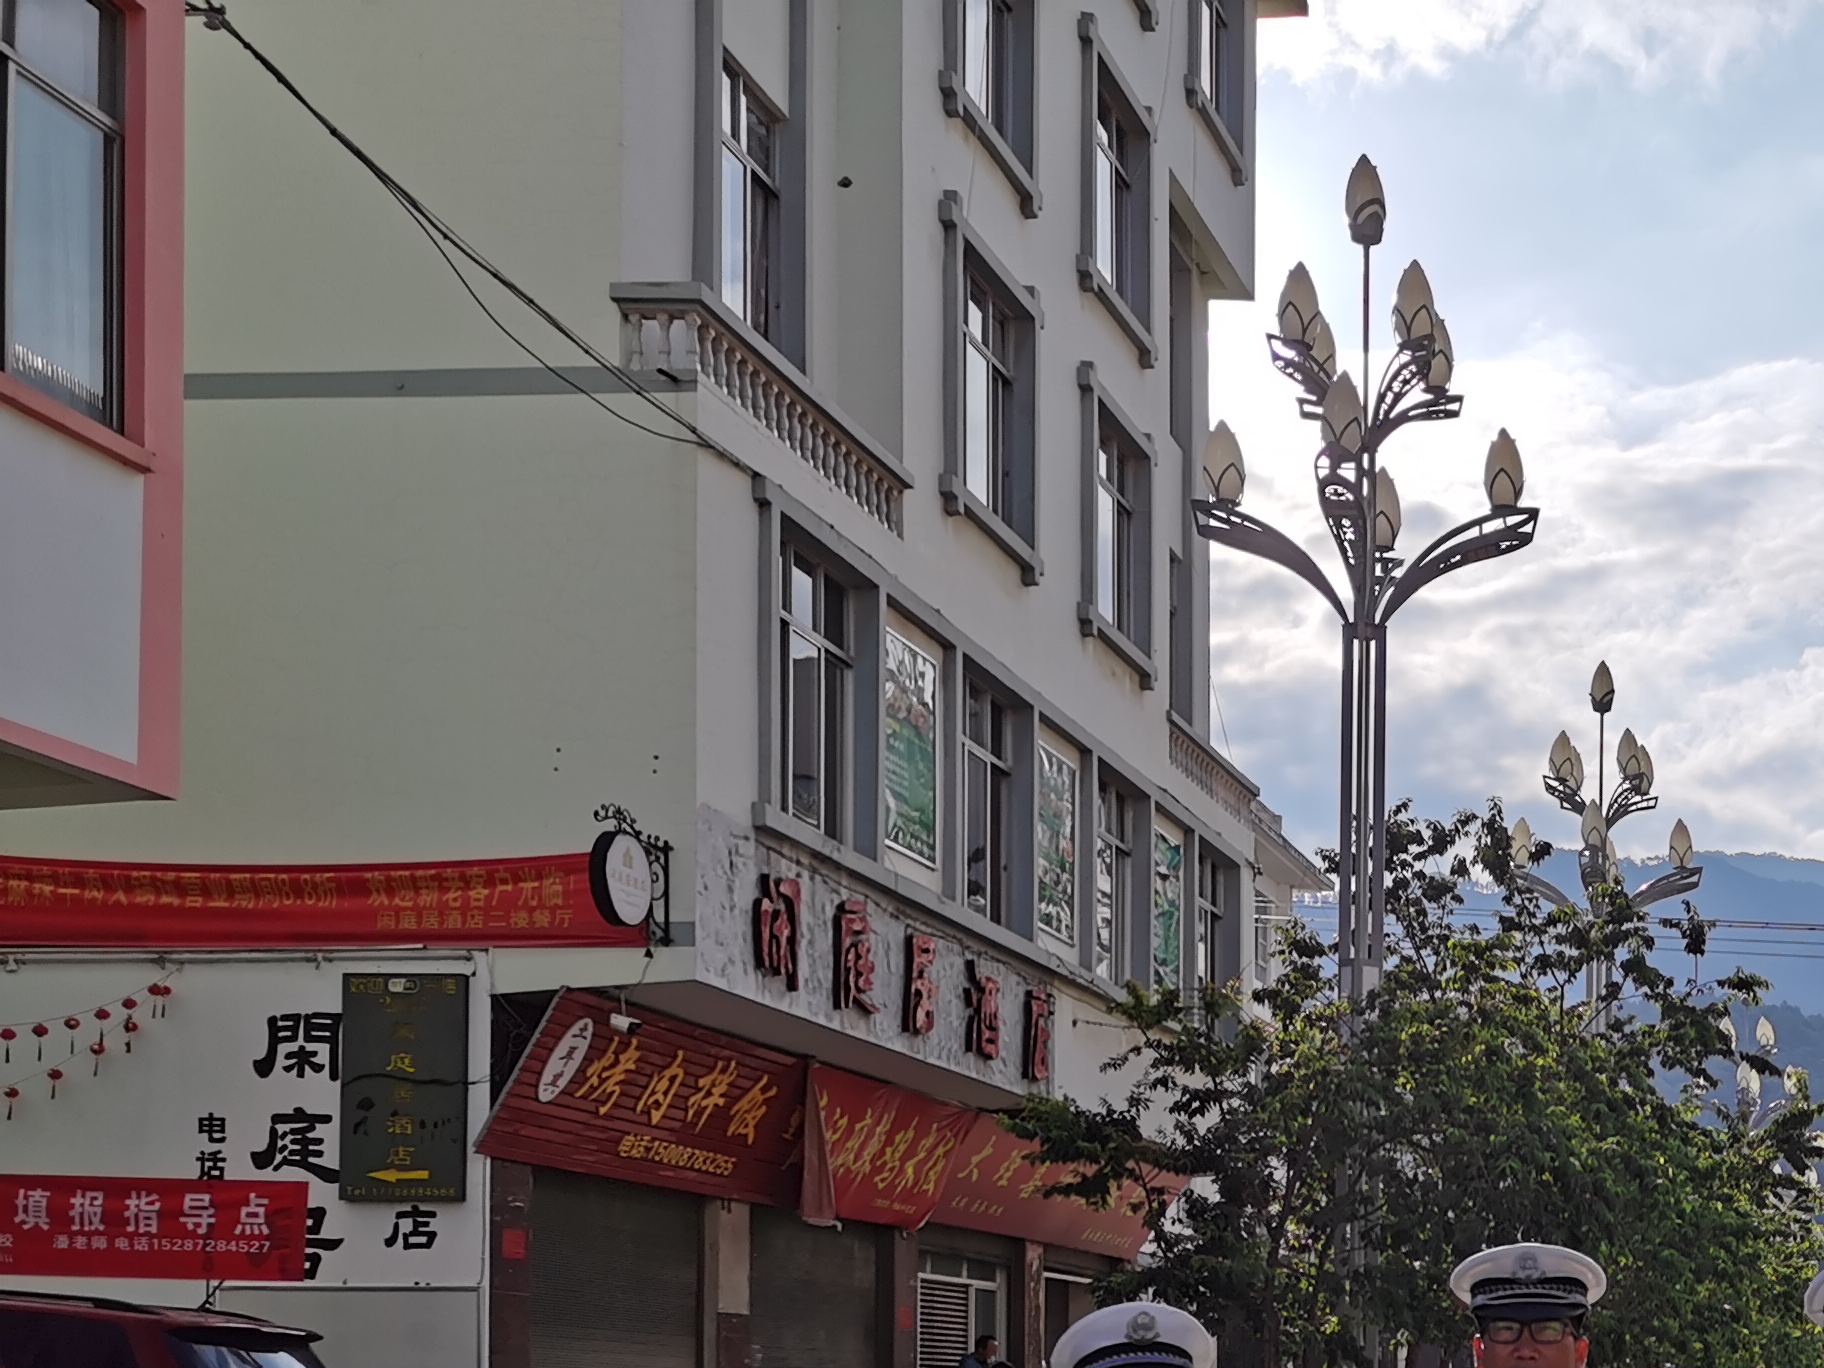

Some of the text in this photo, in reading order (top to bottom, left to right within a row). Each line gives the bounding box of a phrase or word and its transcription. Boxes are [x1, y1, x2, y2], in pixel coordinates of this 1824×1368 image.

[376, 909, 574, 930] 闲庭居酒店二楼餐厅
[574, 1035, 778, 1146] 烤肉拌饭
[13, 1188, 271, 1236] 填报指导点
[52, 1233, 109, 1251] 潘老师
[114, 1236, 271, 1254] 电话15287284527
